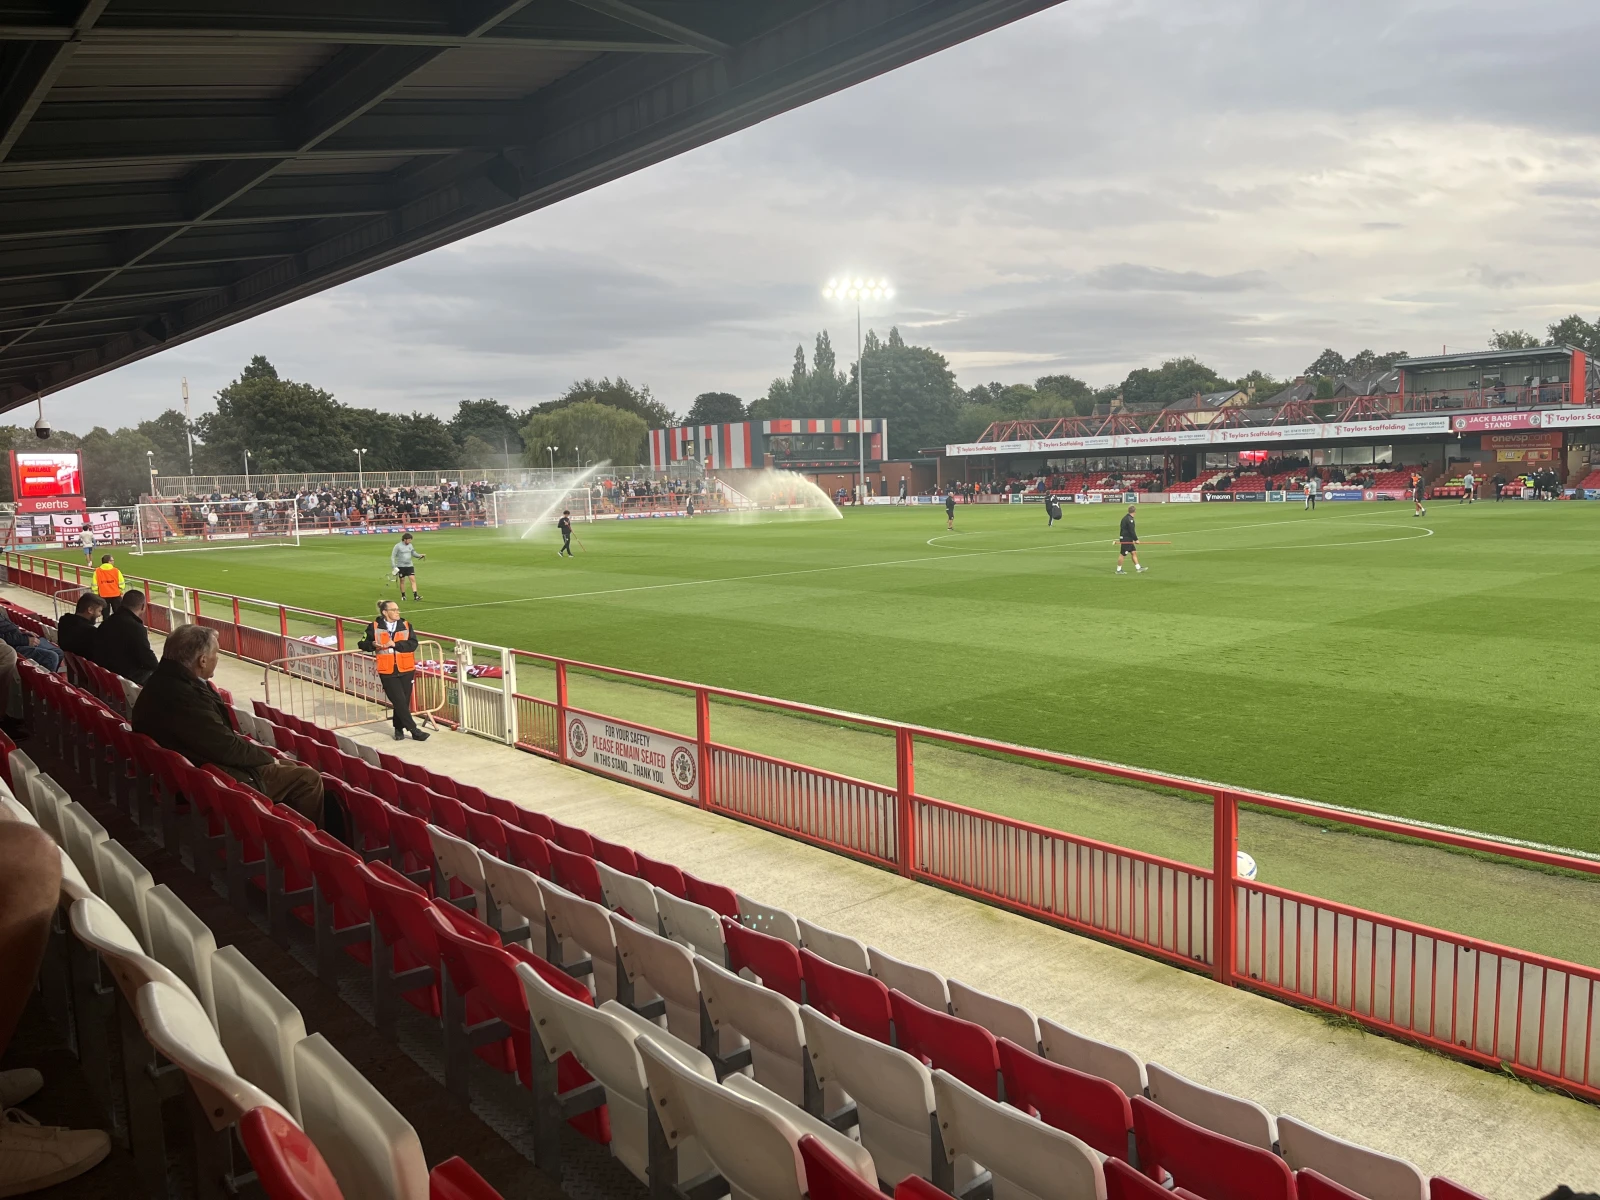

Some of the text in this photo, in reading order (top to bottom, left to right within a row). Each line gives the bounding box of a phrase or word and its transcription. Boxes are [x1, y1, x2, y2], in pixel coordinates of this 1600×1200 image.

[1492, 414, 1528, 422] BARRETT
[1556, 414, 1585, 422] Taylors
[36, 500, 69, 509] exertis
[345, 660, 363, 673] TOIETS
[605, 725, 650, 747] FOR YOUR SAFETY
[592, 735, 614, 754] PLEASE
[615, 742, 640, 761] REMAIN
[641, 749, 666, 769] SEATED
[593, 752, 599, 764] IN
[600, 754, 611, 767] THIS
[633, 764, 651, 780] THANK
[652, 768, 665, 784] YOU.
